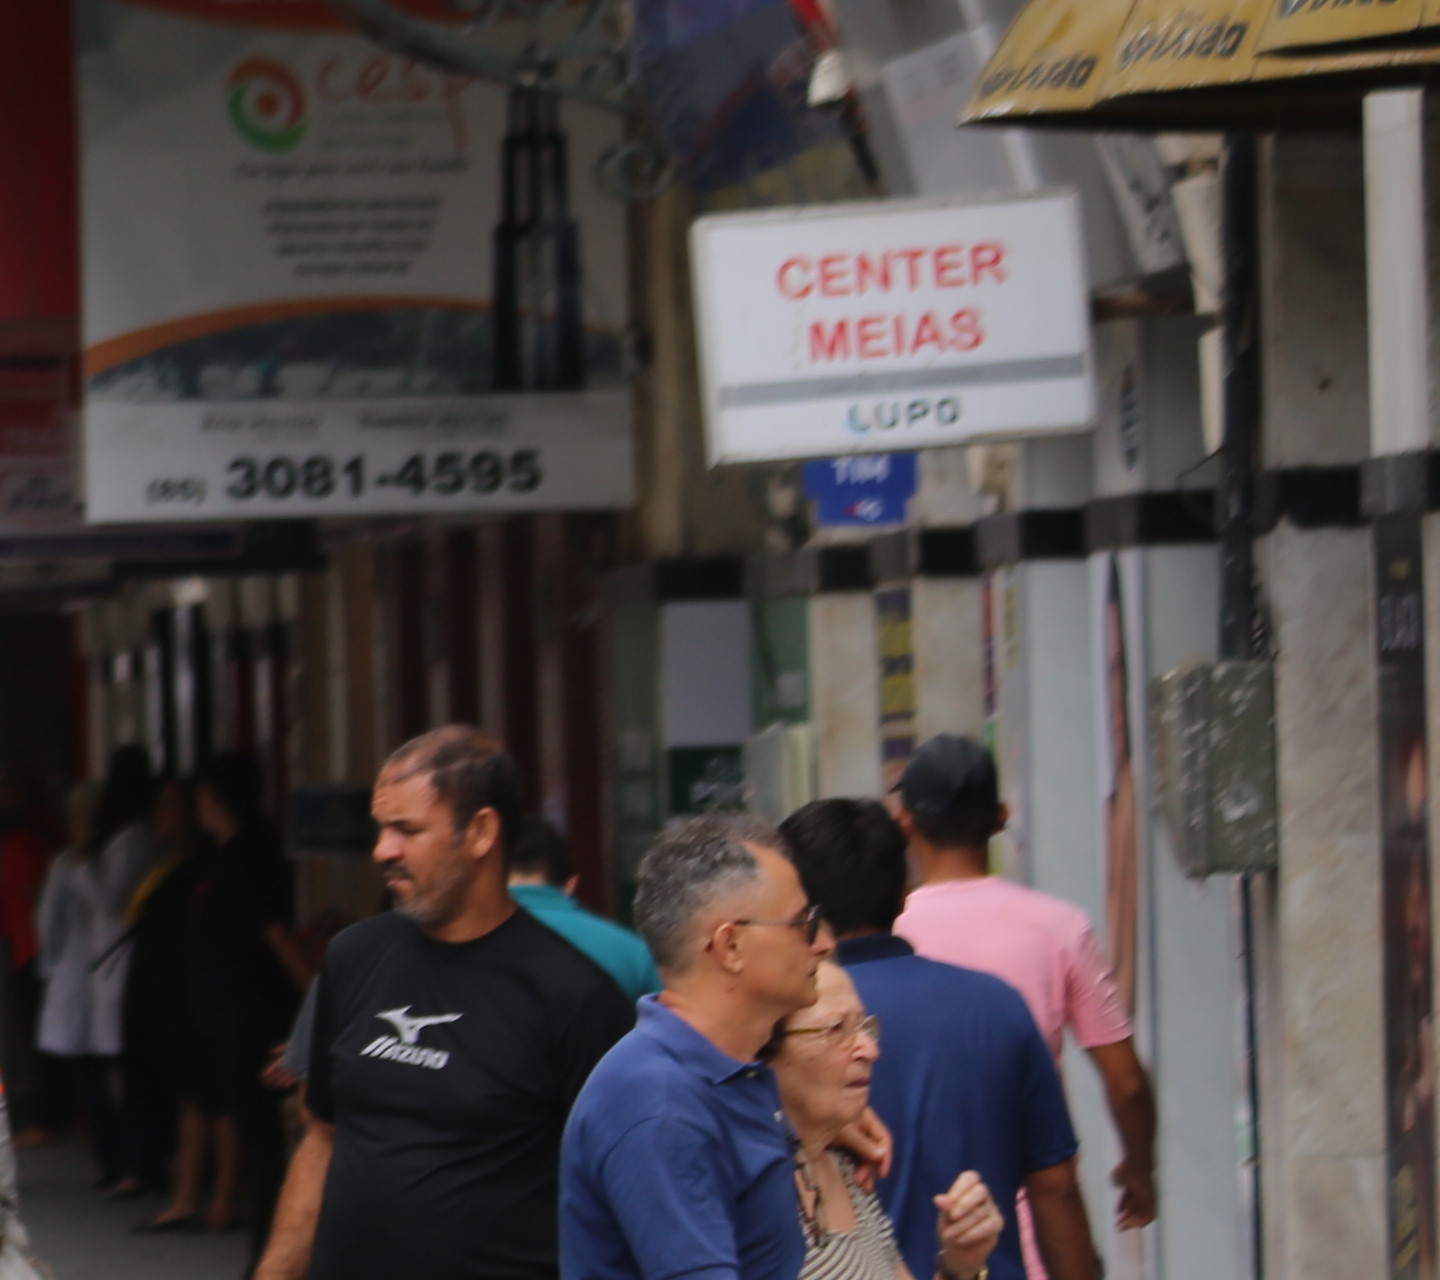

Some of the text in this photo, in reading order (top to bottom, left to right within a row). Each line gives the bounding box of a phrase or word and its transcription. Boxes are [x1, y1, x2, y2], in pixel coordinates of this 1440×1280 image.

[776, 241, 1008, 301] CENTER
[808, 307, 987, 363] MEIAS
[845, 397, 963, 436] LUPO
[225, 448, 543, 500] 3081-4595
